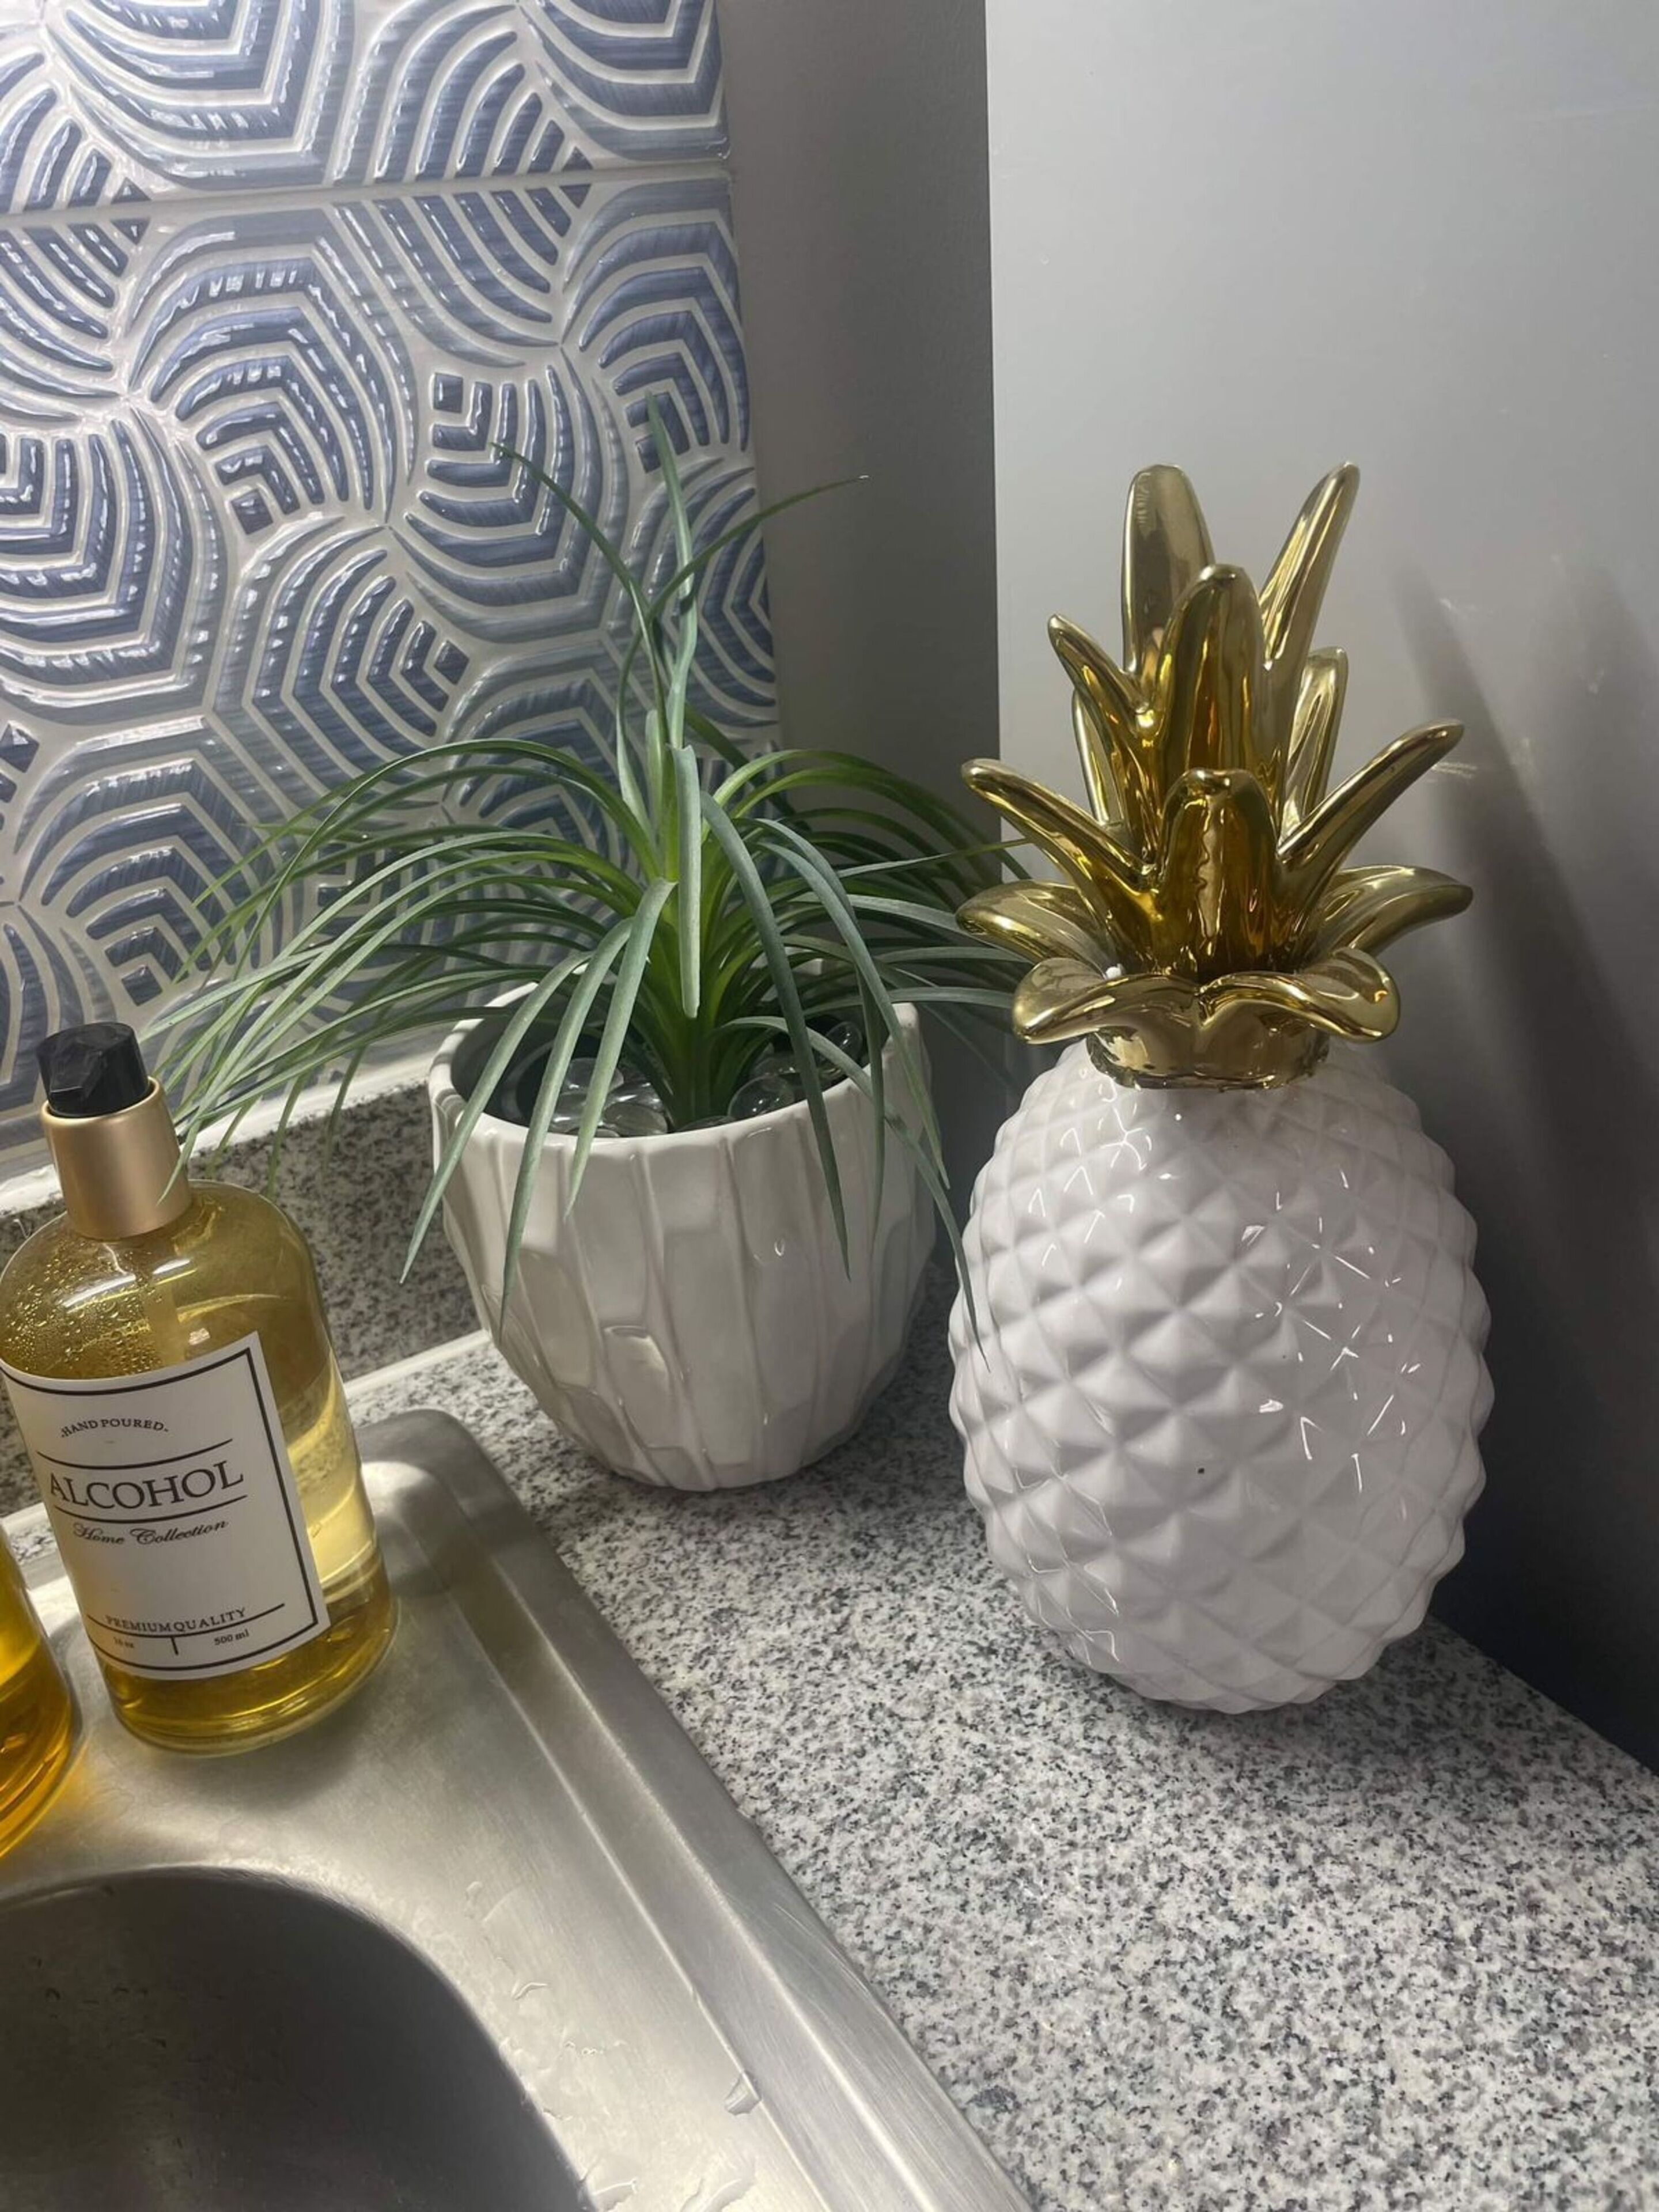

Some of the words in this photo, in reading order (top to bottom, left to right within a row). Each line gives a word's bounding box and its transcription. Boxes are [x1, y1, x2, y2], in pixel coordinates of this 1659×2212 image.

[50, 1460, 244, 1509] ALCOHOL
[73, 1522, 126, 1545] Home
[130, 1520, 229, 1546] Collection
[104, 1615, 171, 1633] PREMIUM
[173, 1607, 246, 1633] QUALITY
[214, 1634, 233, 1646] 500
[235, 1628, 249, 1641] ml
